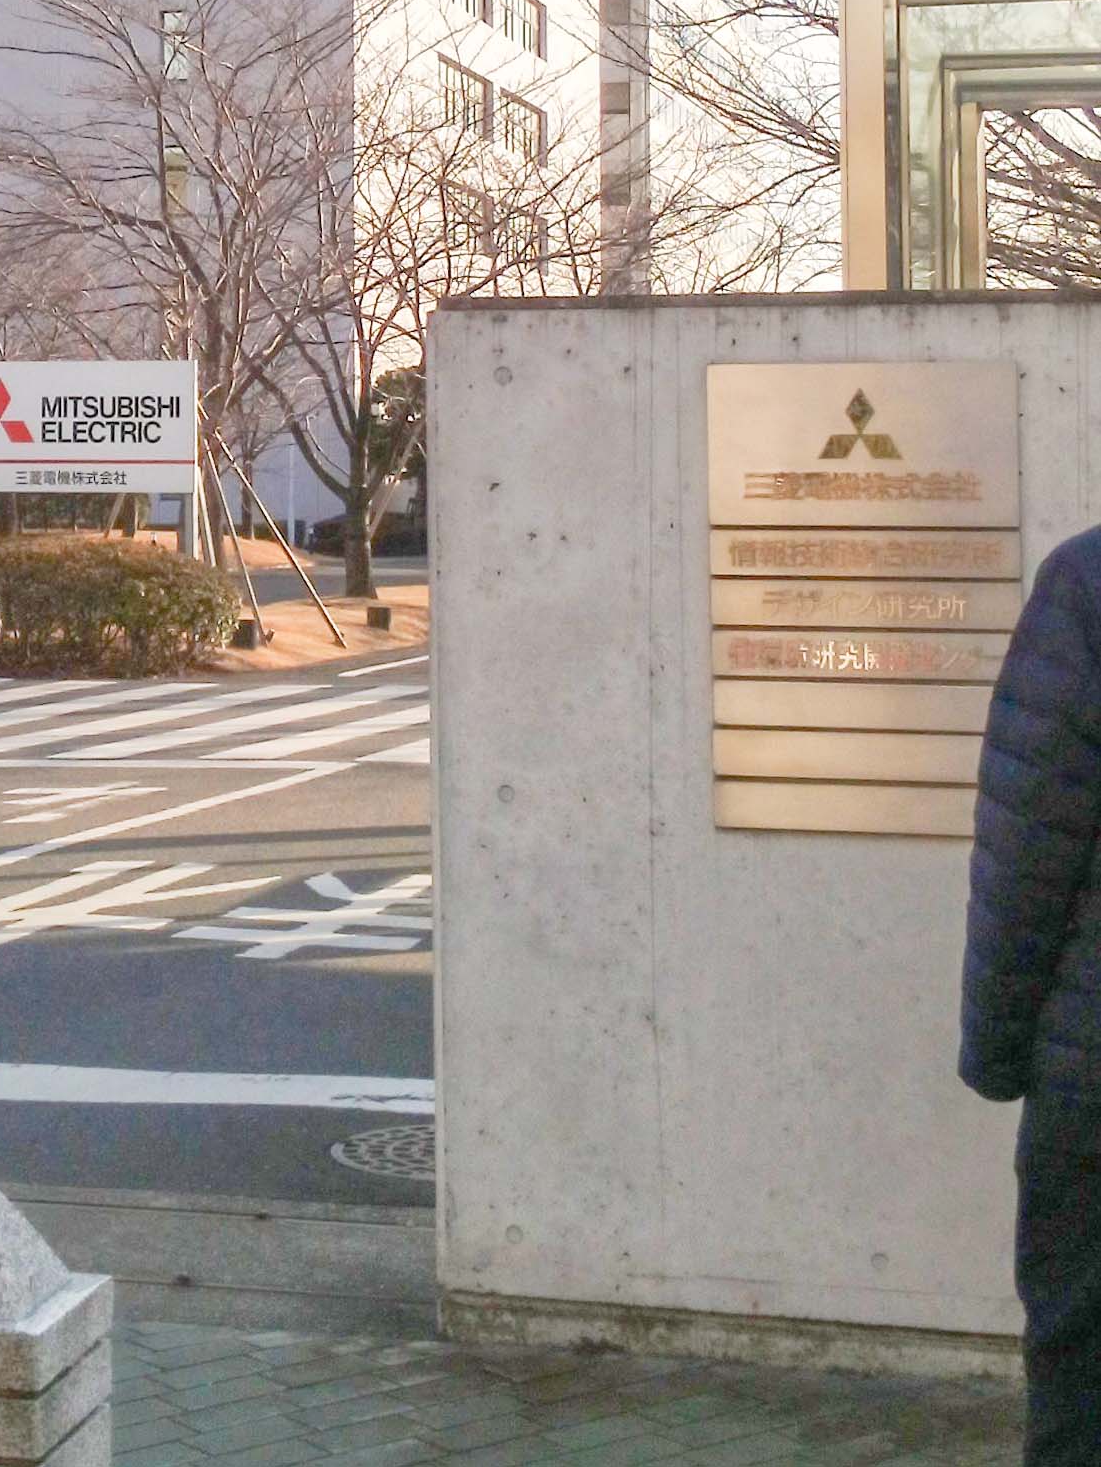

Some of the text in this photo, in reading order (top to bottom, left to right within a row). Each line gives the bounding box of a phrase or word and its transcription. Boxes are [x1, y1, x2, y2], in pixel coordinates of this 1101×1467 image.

[41, 396, 180, 419] MITSUBISHI
[41, 421, 162, 444] ELECTRIC
[15, 470, 128, 486] 三菱電機株式会社
